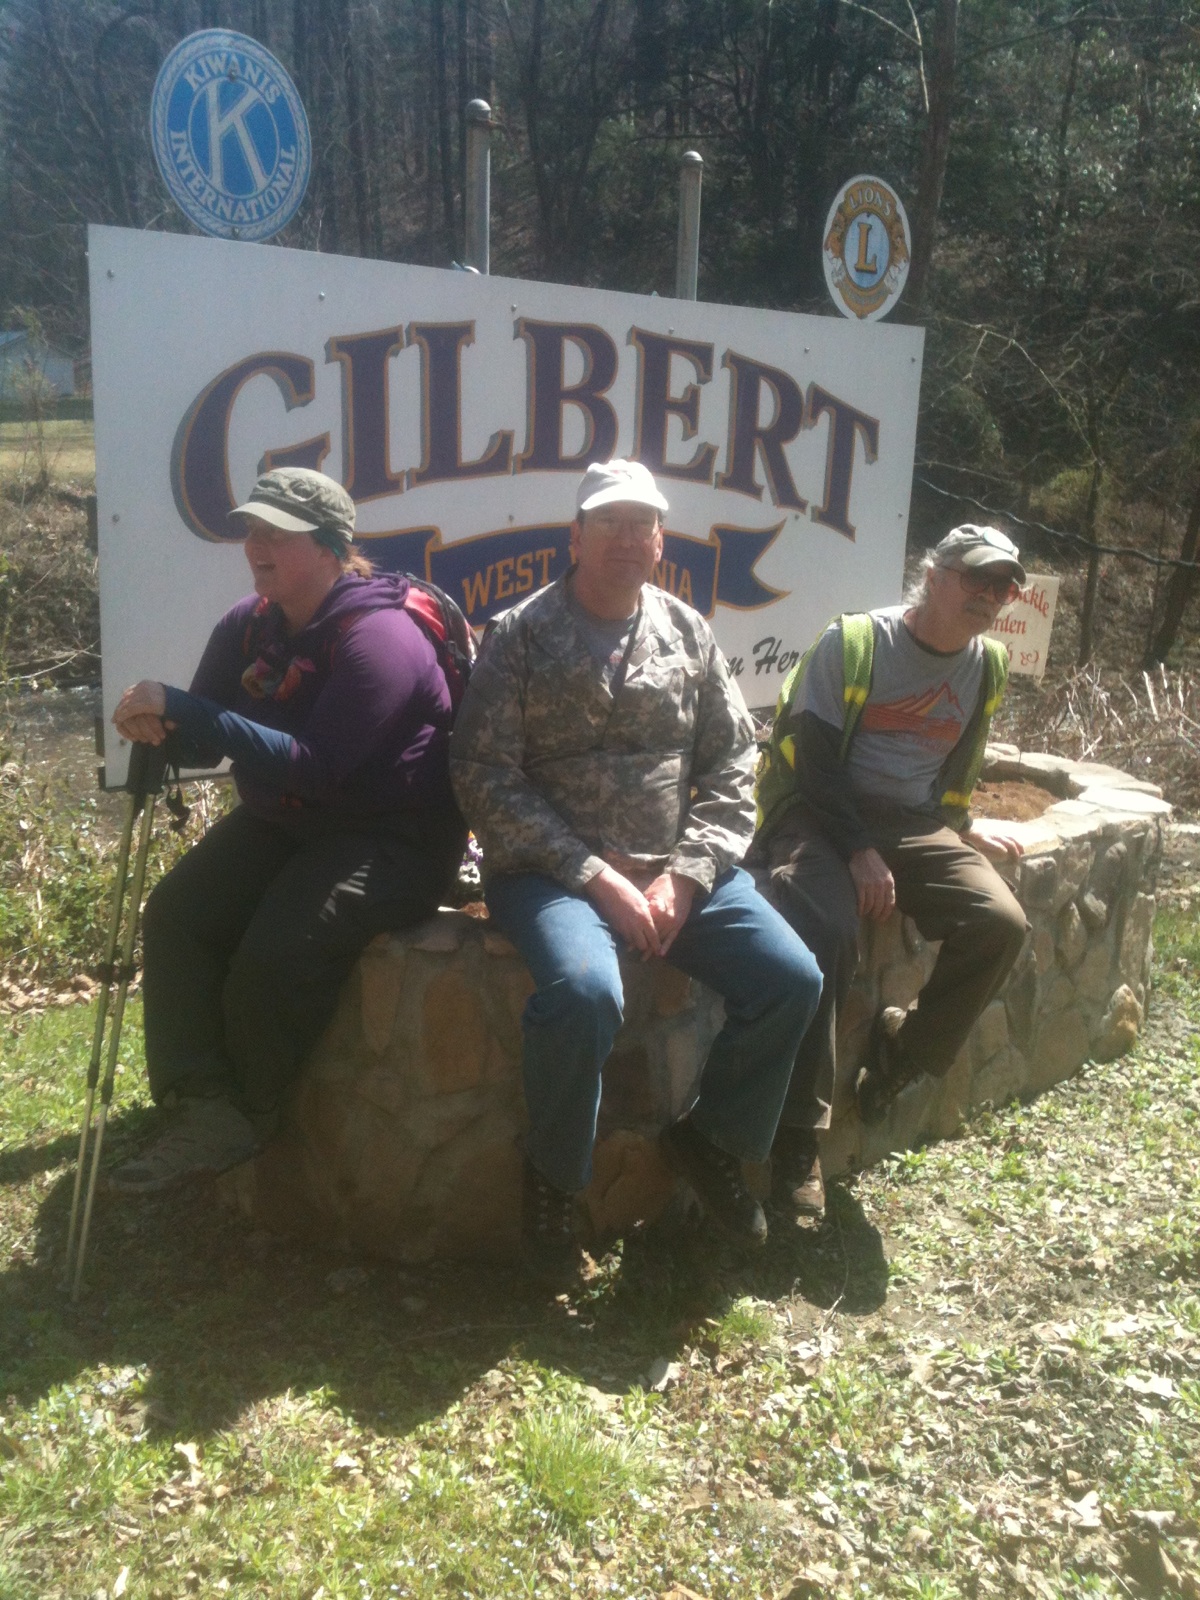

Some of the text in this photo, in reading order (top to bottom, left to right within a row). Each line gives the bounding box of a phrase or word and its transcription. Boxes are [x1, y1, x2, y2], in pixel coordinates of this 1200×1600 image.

[184, 52, 281, 104] KIWANIS
[206, 79, 271, 197] K
[169, 130, 296, 222] INTERNATIONAL
[849, 187, 891, 217] LIONS
[854, 222, 878, 275] L
[169, 316, 880, 544] GILBERT
[462, 547, 557, 616] WEST
[994, 613, 1027, 635] rden
